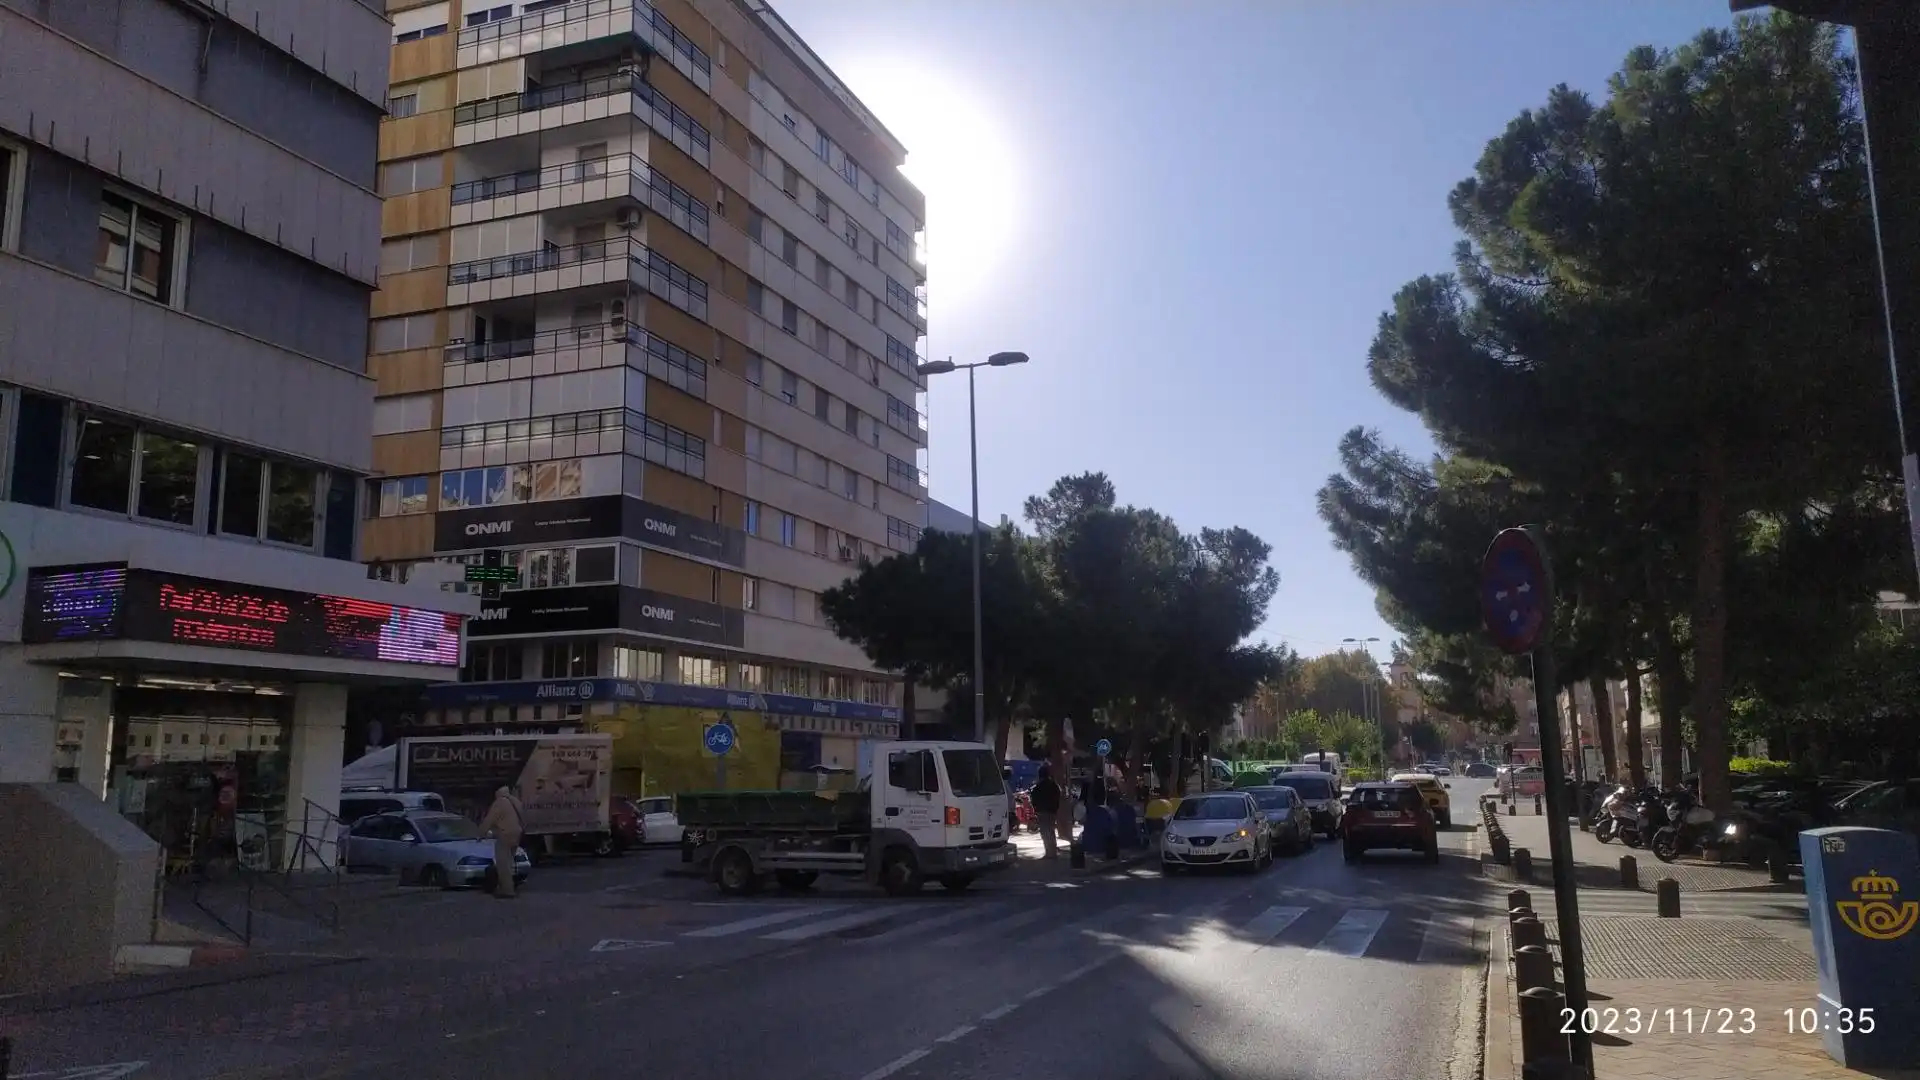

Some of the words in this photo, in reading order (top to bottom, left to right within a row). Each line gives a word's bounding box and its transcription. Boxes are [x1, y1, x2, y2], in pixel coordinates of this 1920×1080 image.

[465, 521, 511, 536] ONMI
[643, 518, 676, 537] ONMI
[469, 607, 507, 621] NMI
[640, 604, 674, 621] ONMI
[536, 684, 575, 699] Allianz
[447, 746, 521, 763] MONTIEL
